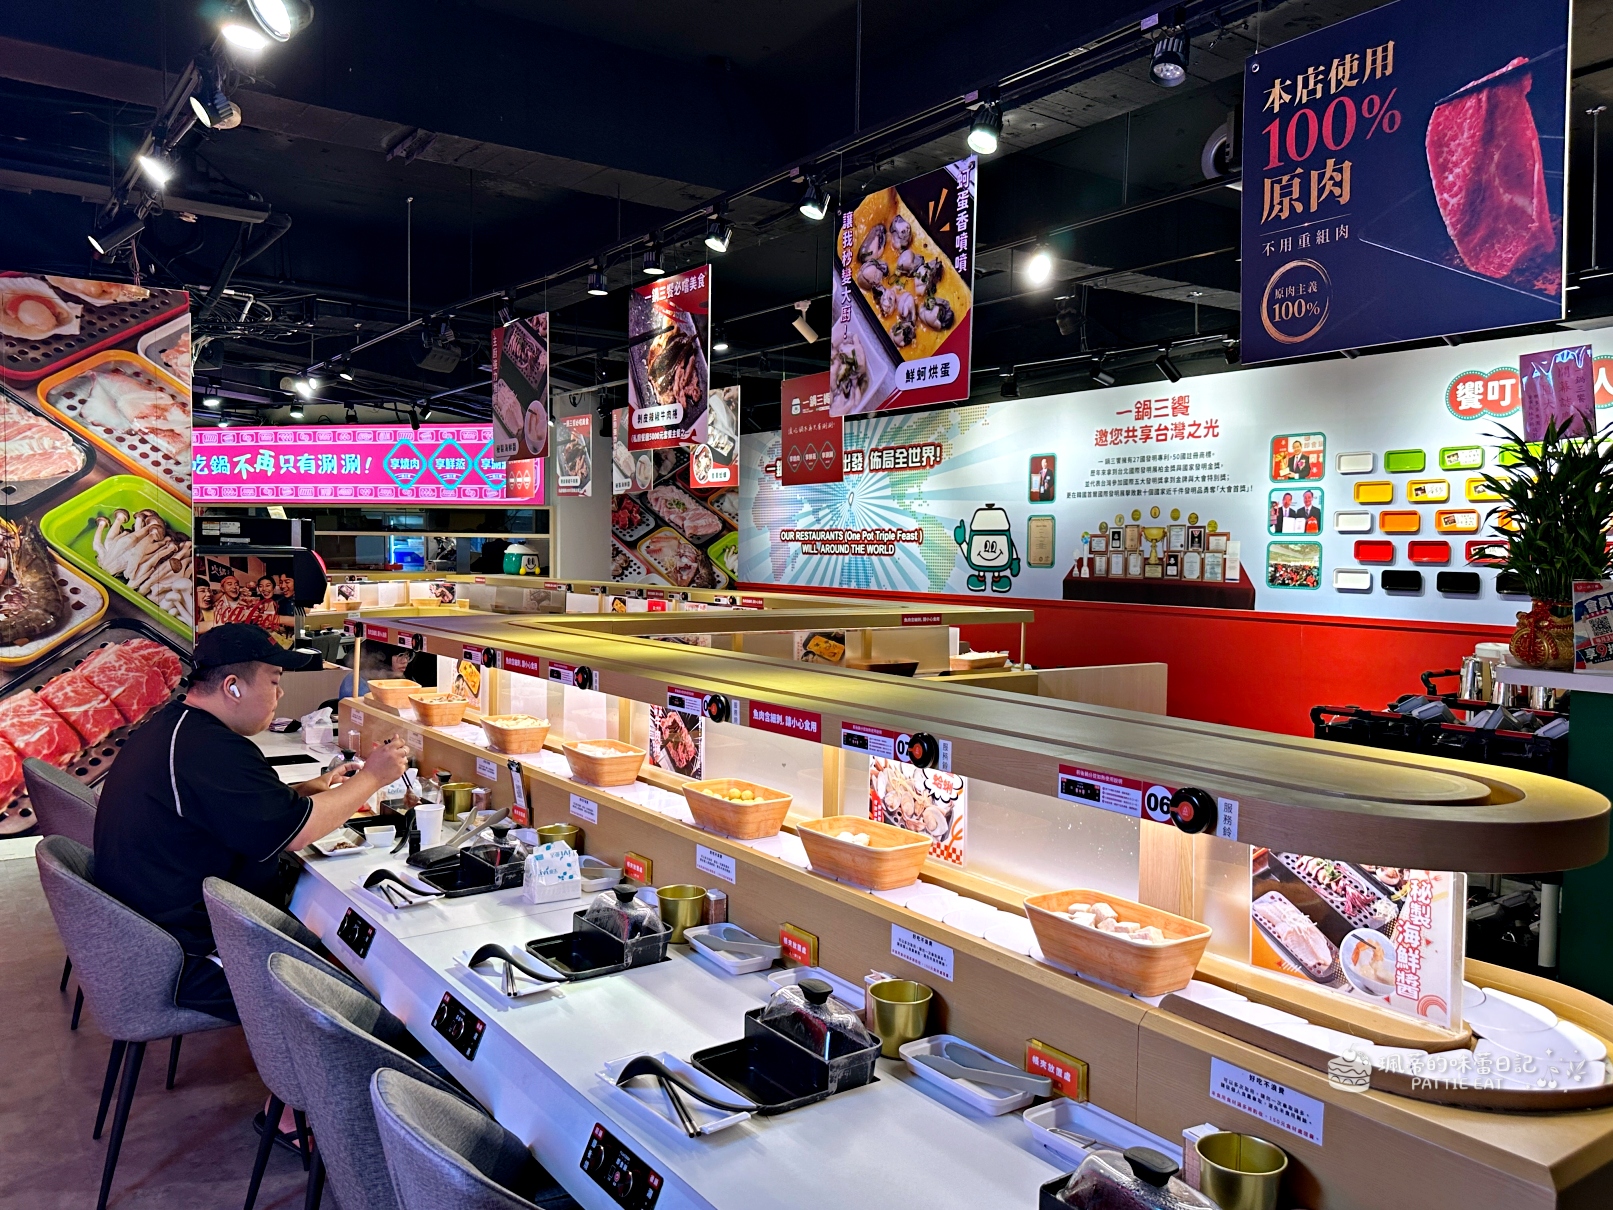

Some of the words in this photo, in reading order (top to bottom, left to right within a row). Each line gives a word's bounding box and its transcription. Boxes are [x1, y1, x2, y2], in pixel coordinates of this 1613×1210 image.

[1262, 40, 1395, 114] 本店使用
[1261, 87, 1402, 171] 100%
[1260, 158, 1353, 225] 原肉
[955, 168, 971, 273] 蚵蛋香噴噴
[1262, 225, 1350, 257] 不用重組肉
[1274, 281, 1318, 300] 原肉主義
[1272, 299, 1320, 322] 100%
[905, 363, 951, 384] 鮮蚵烘蛋
[1116, 395, 1190, 421] 一鍋三饗
[1094, 419, 1220, 447] 邀您共享台灣之光
[192, 449, 373, 480] 吃鍋不再只有涮涮!
[390, 458, 420, 470] 享燒肉
[436, 458, 466, 470] 享鮮蒸
[870, 444, 941, 471] 佈局全世界!
[781, 531, 795, 541] OUR
[796, 530, 843, 541] RESTAURANTS
[862, 530, 875, 540] Pot
[876, 530, 896, 542] Triple
[897, 529, 918, 541] Feast
[802, 544, 819, 553] WILL
[820, 544, 850, 554] AROUND
[851, 544, 865, 554] THE
[866, 544, 895, 554] WORLD
[1146, 793, 1171, 815] 06
[1222, 803, 1232, 838] 服務鈴
[1395, 878, 1434, 1001] 秘製海鮮醬
[1249, 1074, 1285, 1096] 好吃不浪費
